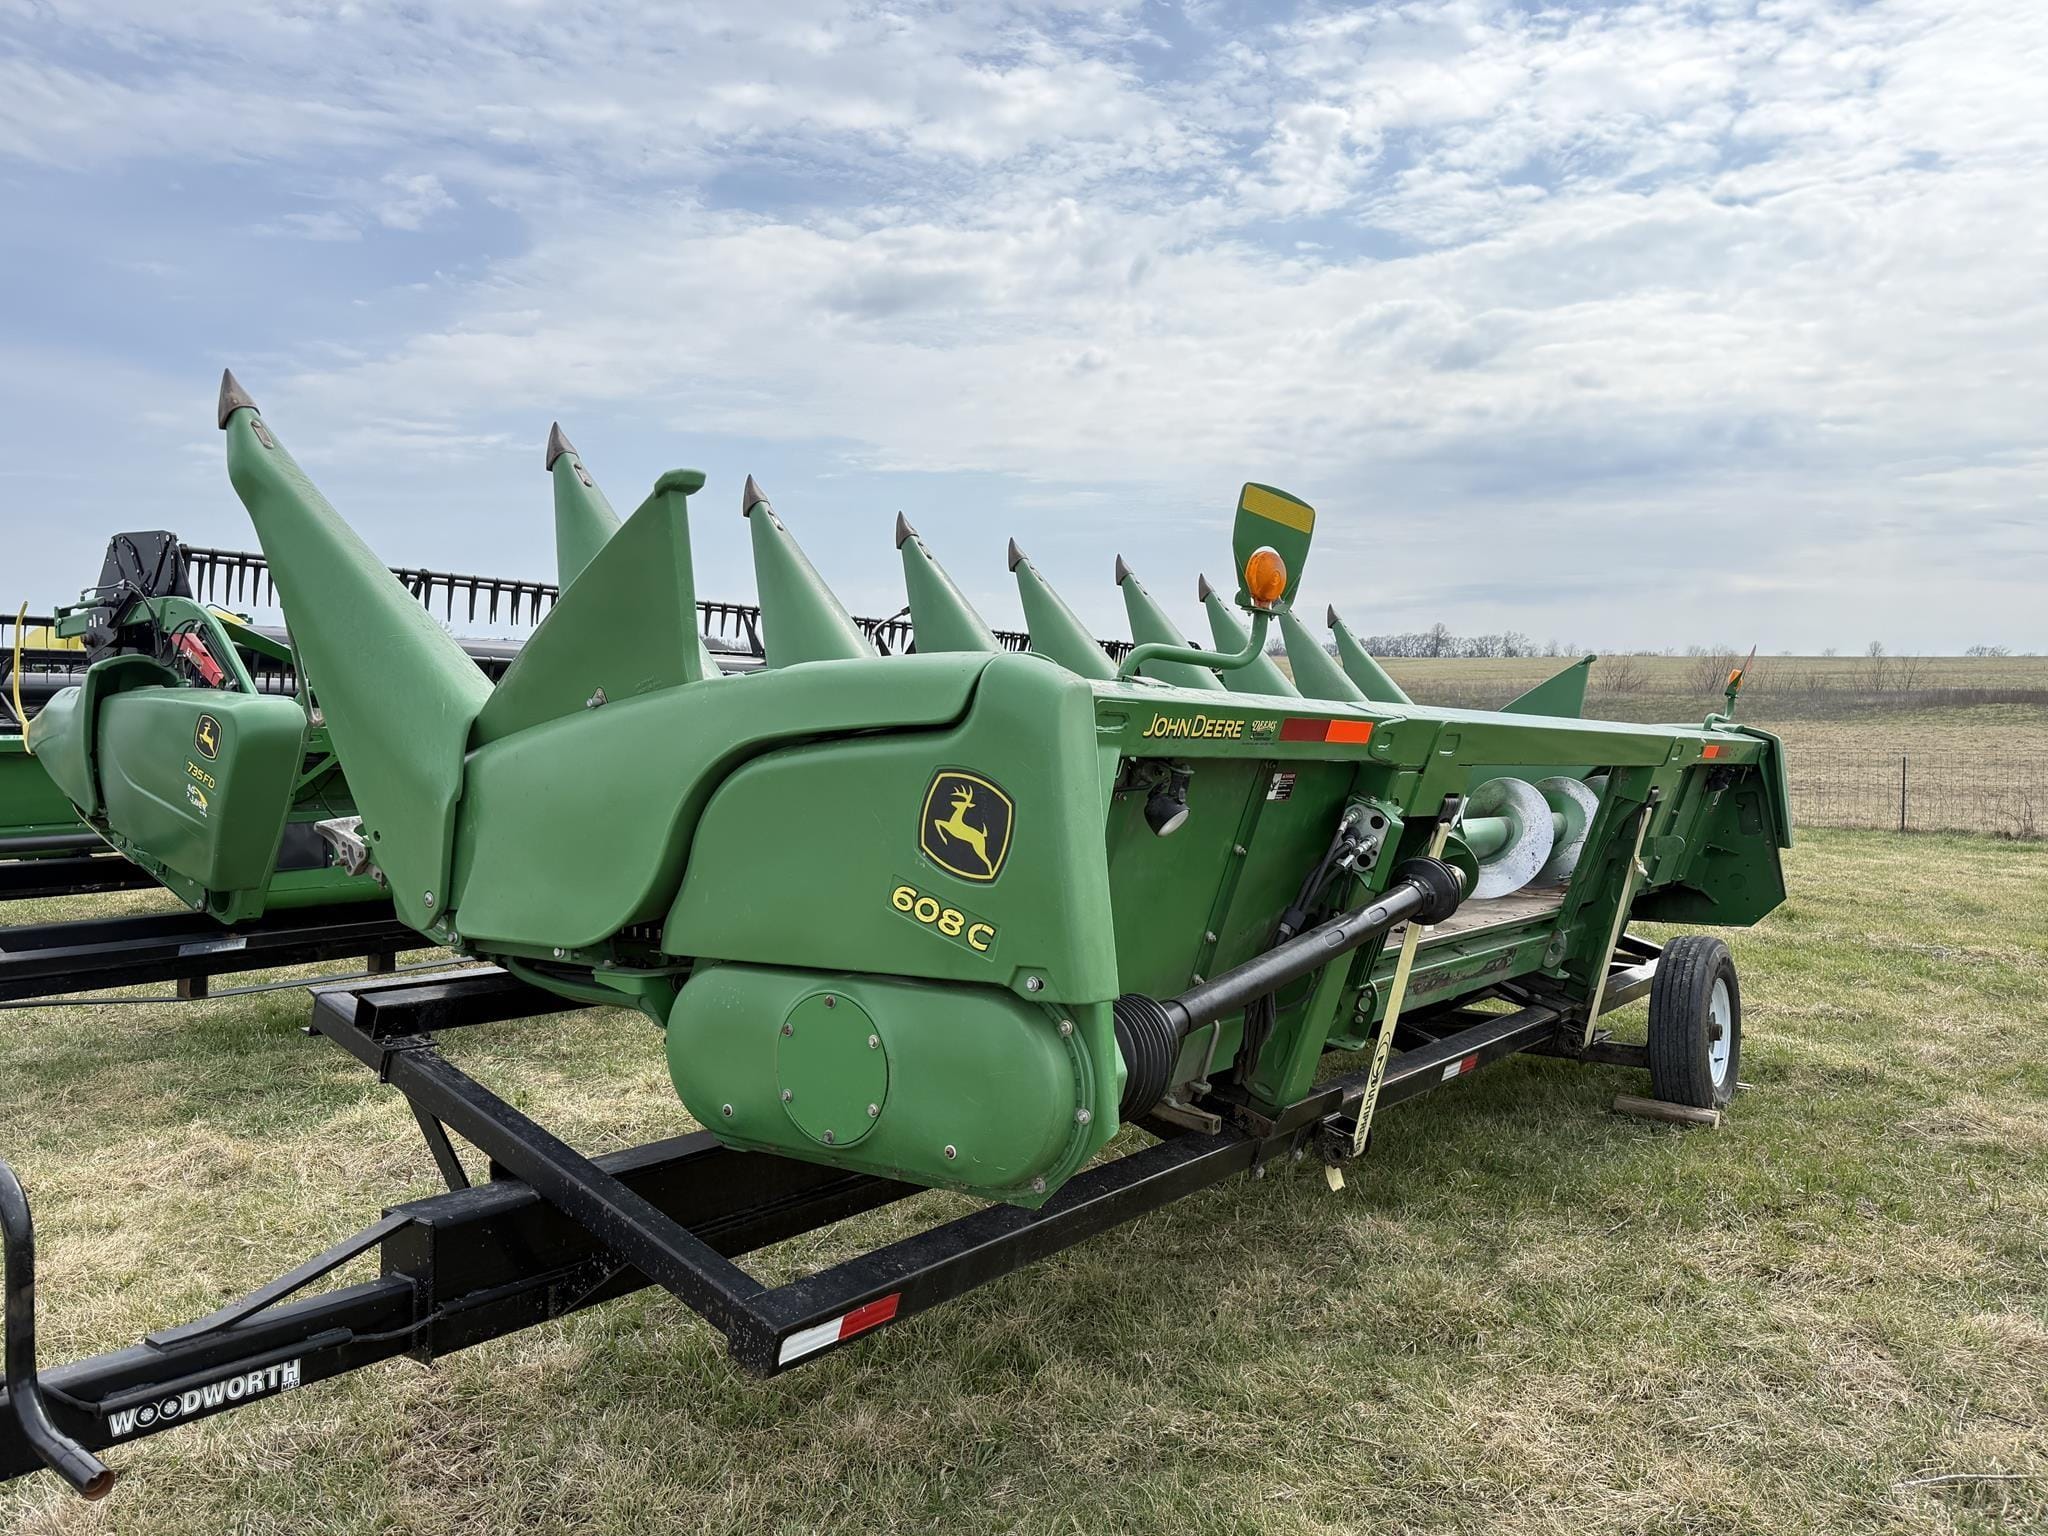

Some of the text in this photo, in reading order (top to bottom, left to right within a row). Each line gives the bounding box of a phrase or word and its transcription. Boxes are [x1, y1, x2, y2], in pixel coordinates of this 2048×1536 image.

[1143, 713, 1245, 739] JOHN DEERE
[108, 1358, 301, 1438] WOODWORTH
[282, 1381, 300, 1391] MFG
